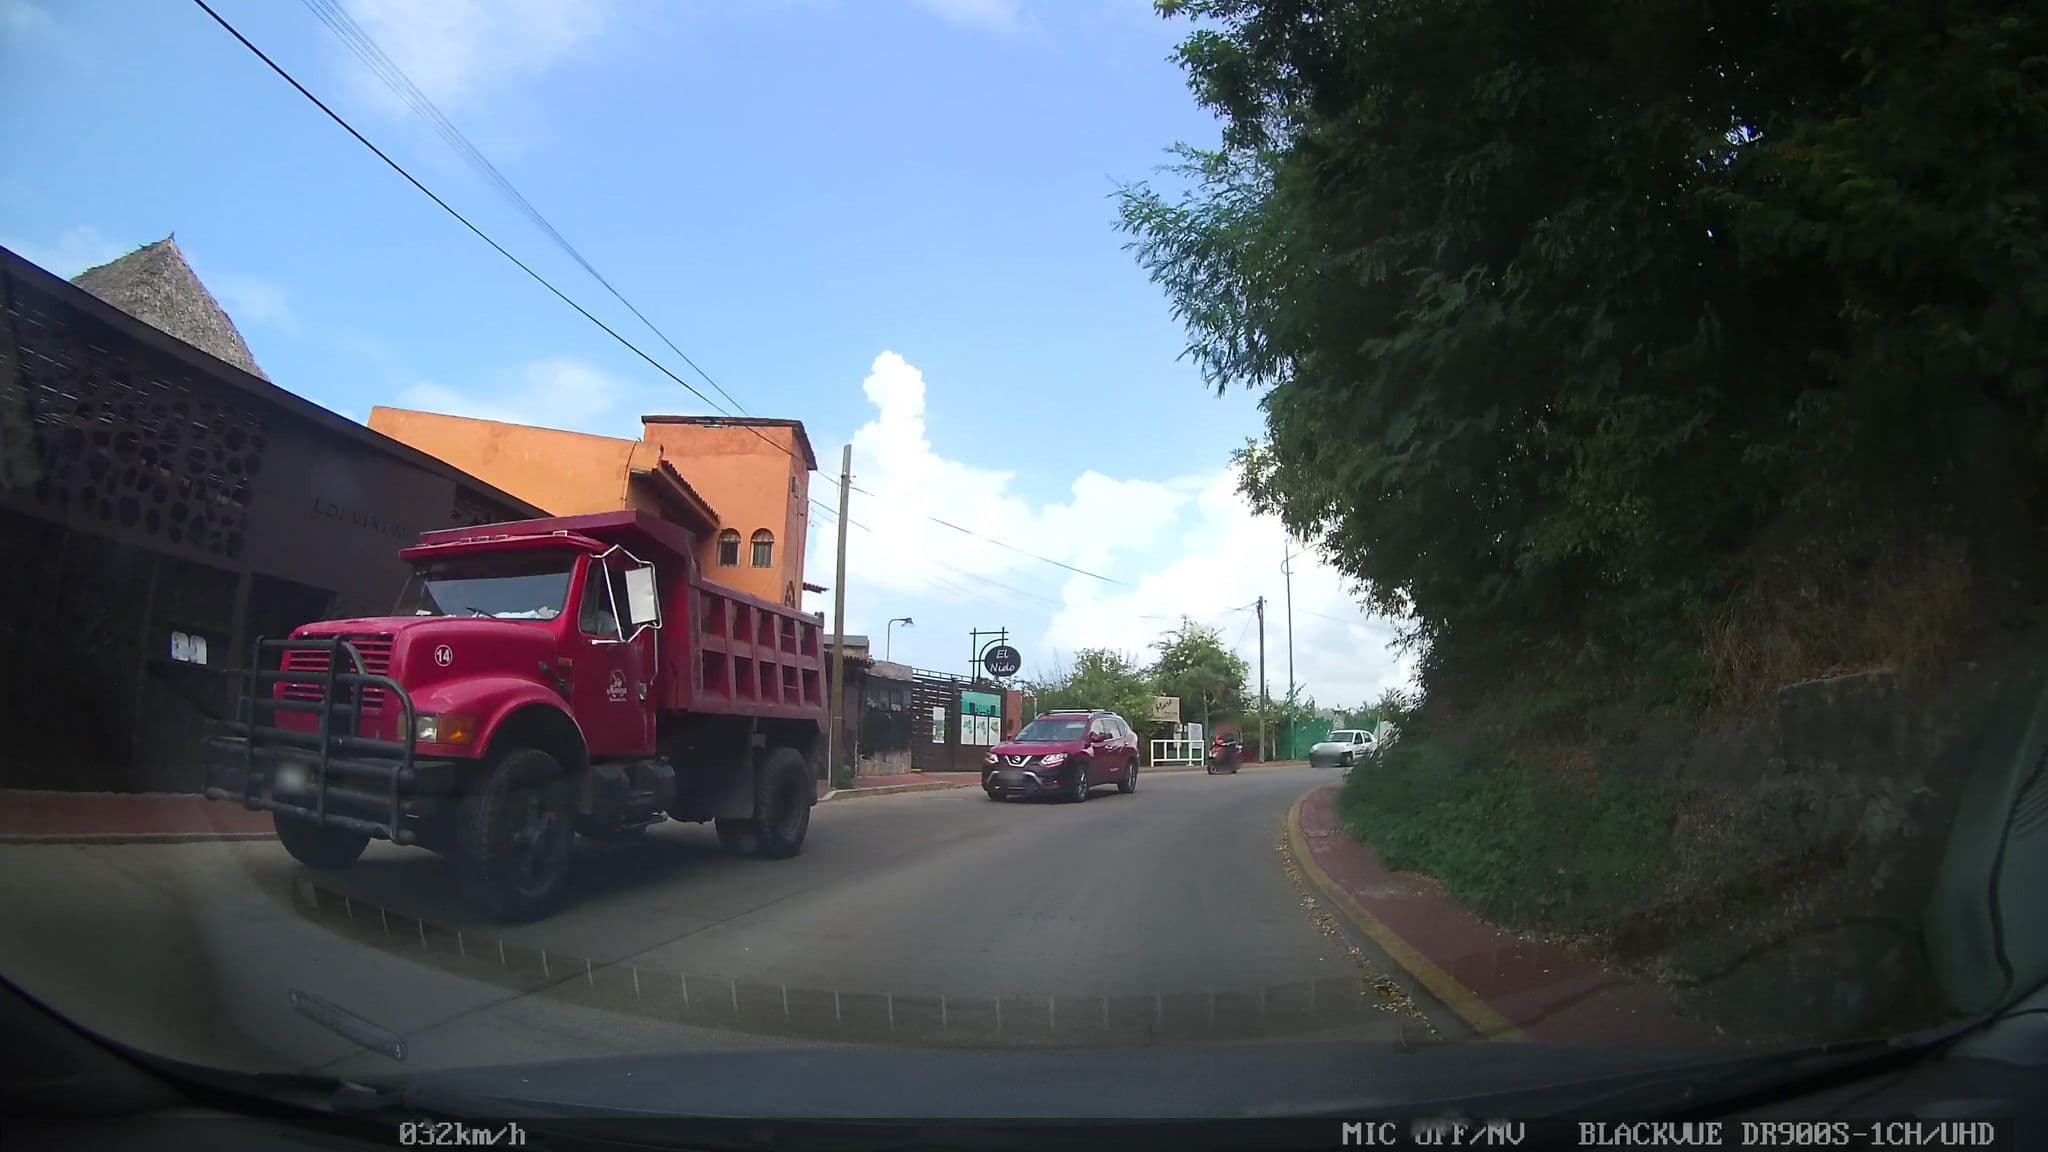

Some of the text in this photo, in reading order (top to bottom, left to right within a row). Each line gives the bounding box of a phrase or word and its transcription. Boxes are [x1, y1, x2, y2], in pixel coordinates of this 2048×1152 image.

[436, 649, 450, 662] 14
[996, 649, 1009, 659] El
[990, 662, 1016, 672] Nido
